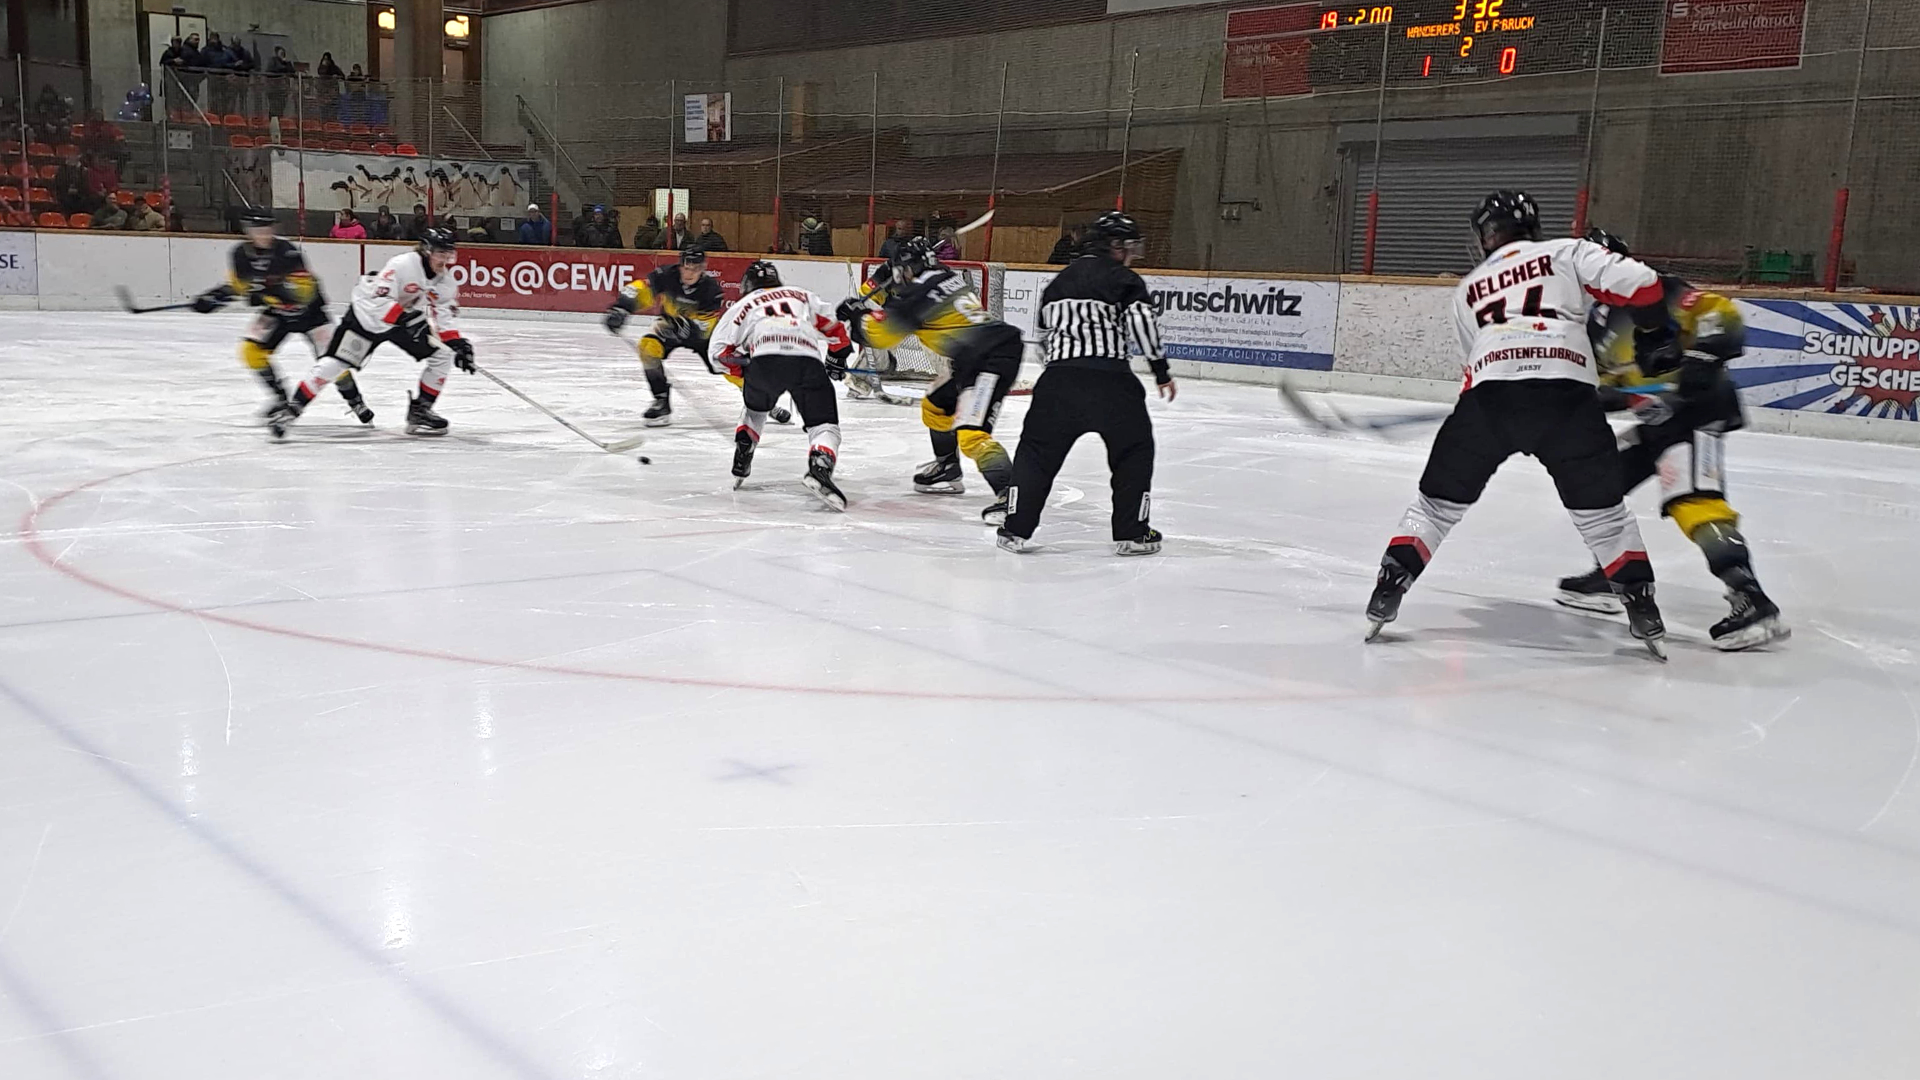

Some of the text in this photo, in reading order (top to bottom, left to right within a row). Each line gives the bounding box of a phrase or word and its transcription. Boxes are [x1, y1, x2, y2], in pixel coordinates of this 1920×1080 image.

[1320, 11, 1338, 30] 19
[1406, 22, 1461, 39] WANDERERS
[1474, 20, 1489, 34] EV
[1460, 36, 1473, 57] 2
[1422, 55, 1432, 77] 1
[1500, 47, 1517, 74] 0
[451, 259, 635, 295] obs@CEWE
[1150, 285, 1303, 317] gruschwitz
[733, 303, 753, 326] VON
[1163, 345, 1285, 362] RUSCHWITZ-FACILITY.DE
[1804, 331, 1920, 361] SCHNUPP
